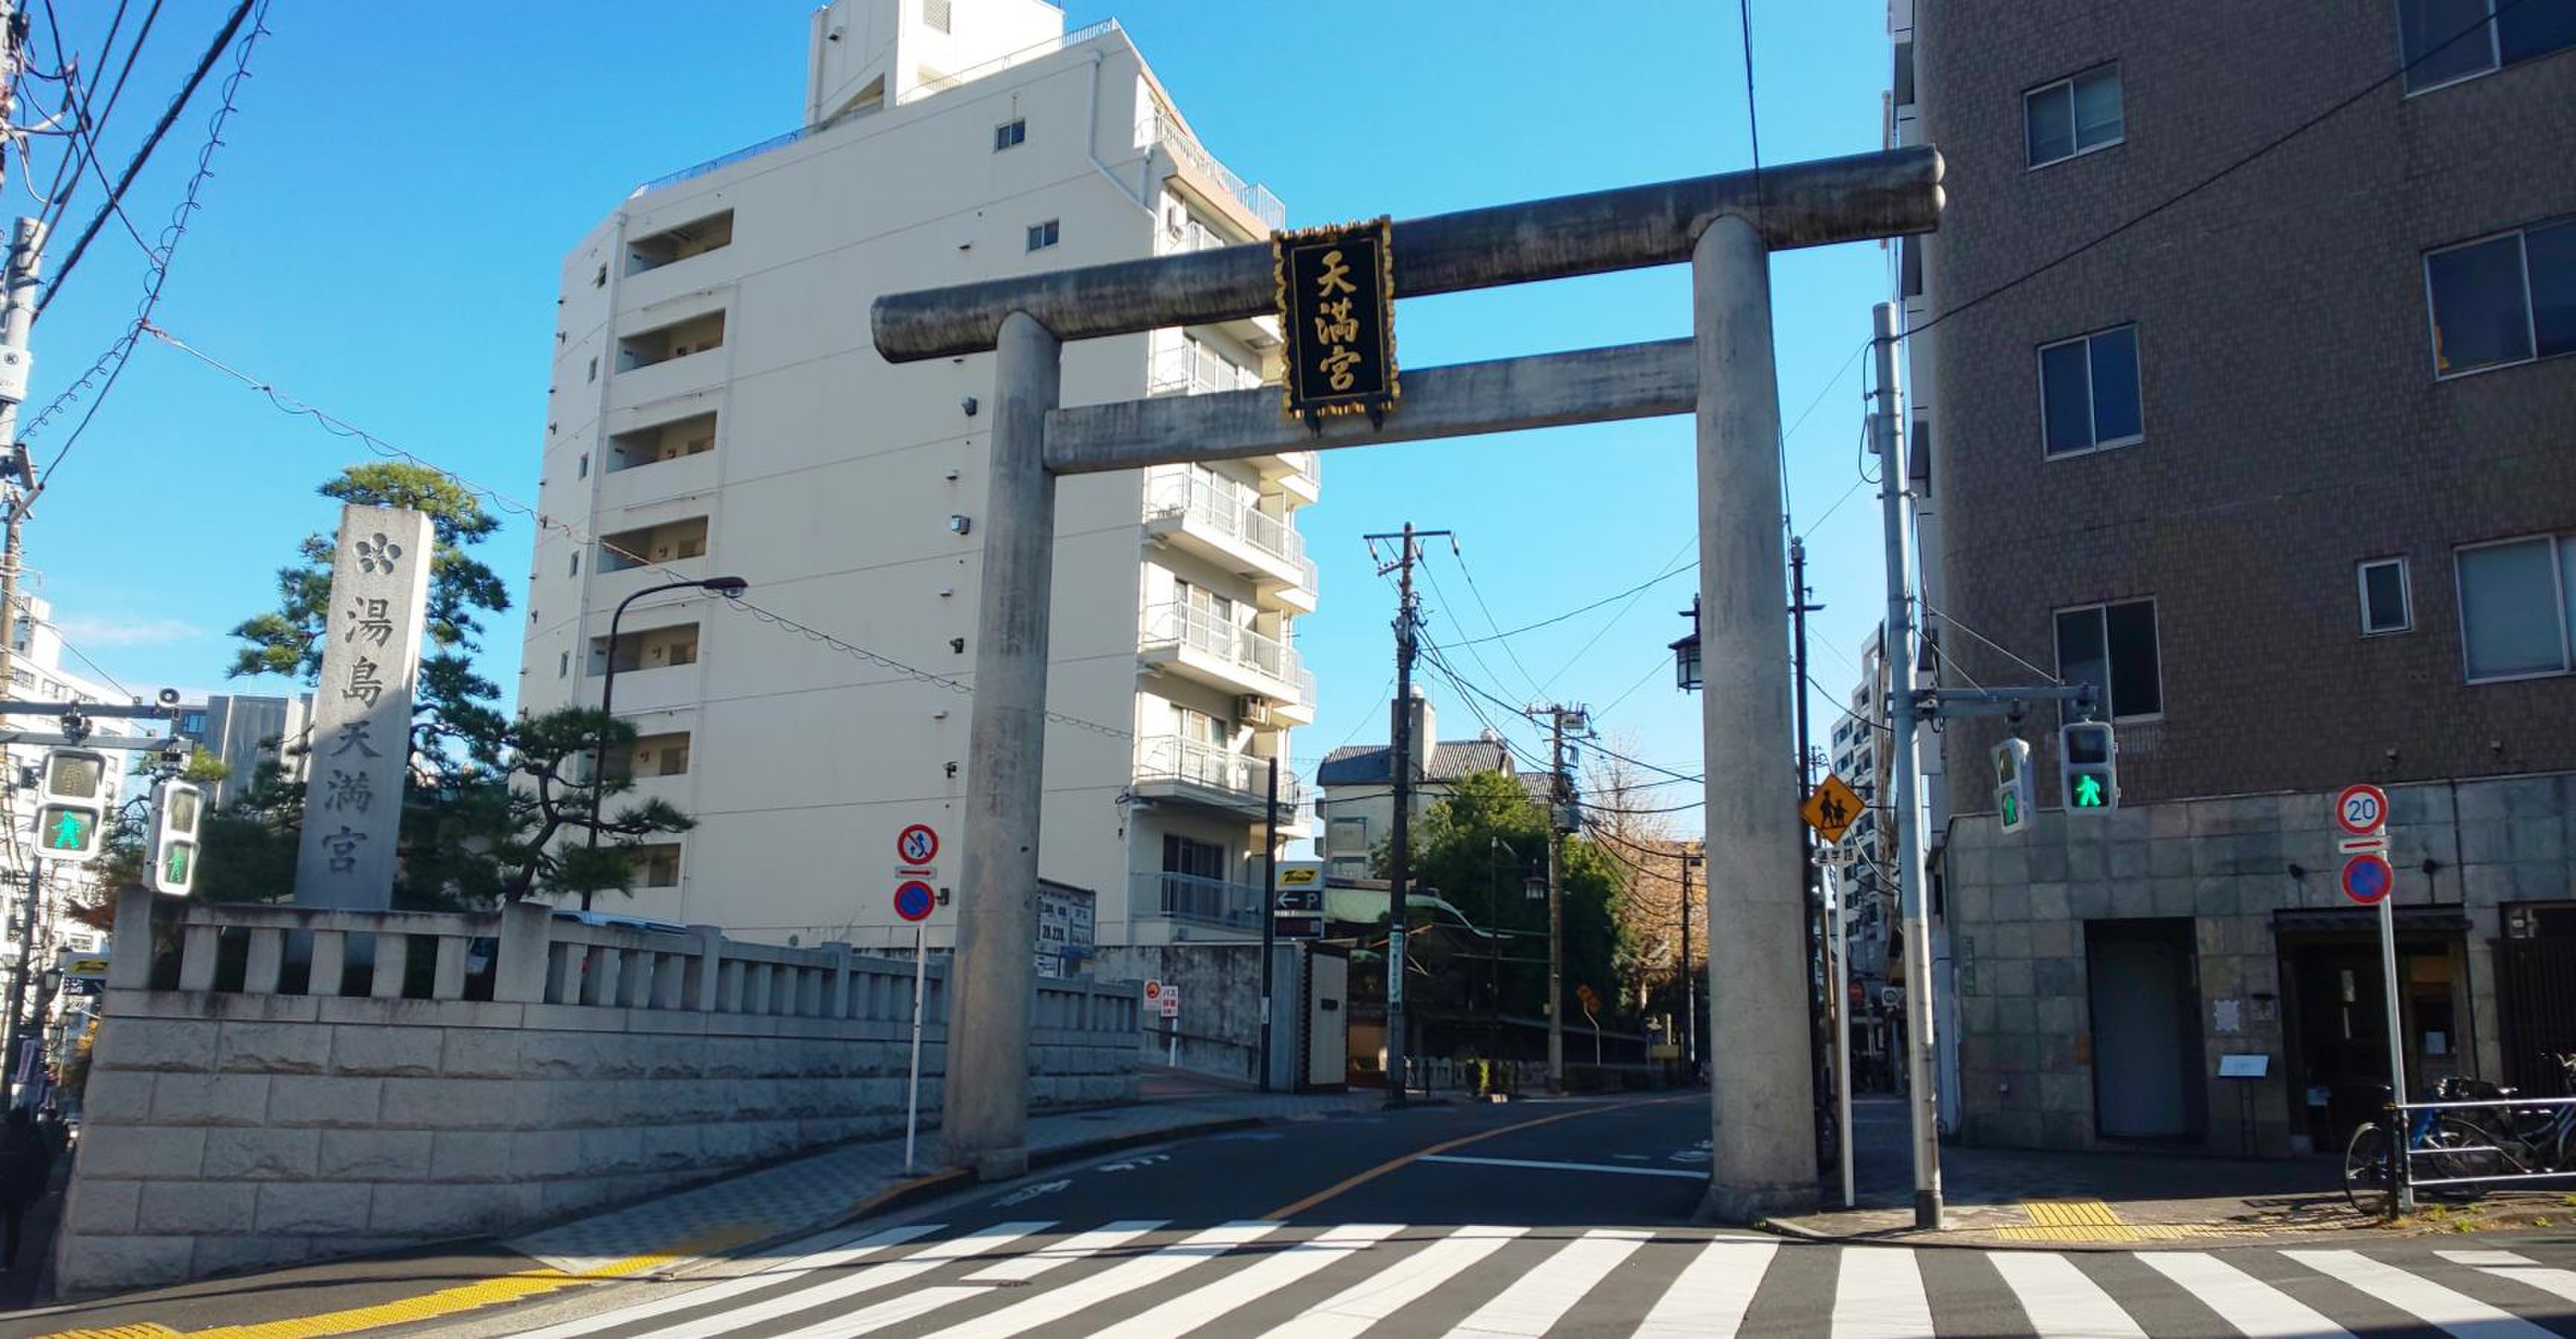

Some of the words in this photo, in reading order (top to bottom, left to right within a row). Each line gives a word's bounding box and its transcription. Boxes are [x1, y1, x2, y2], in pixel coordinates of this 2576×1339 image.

[1314, 248, 1362, 391] 天満宮
[321, 595, 394, 875] 湯島天満宮
[2347, 798, 2376, 822] 20
[1307, 893, 1318, 909] P
